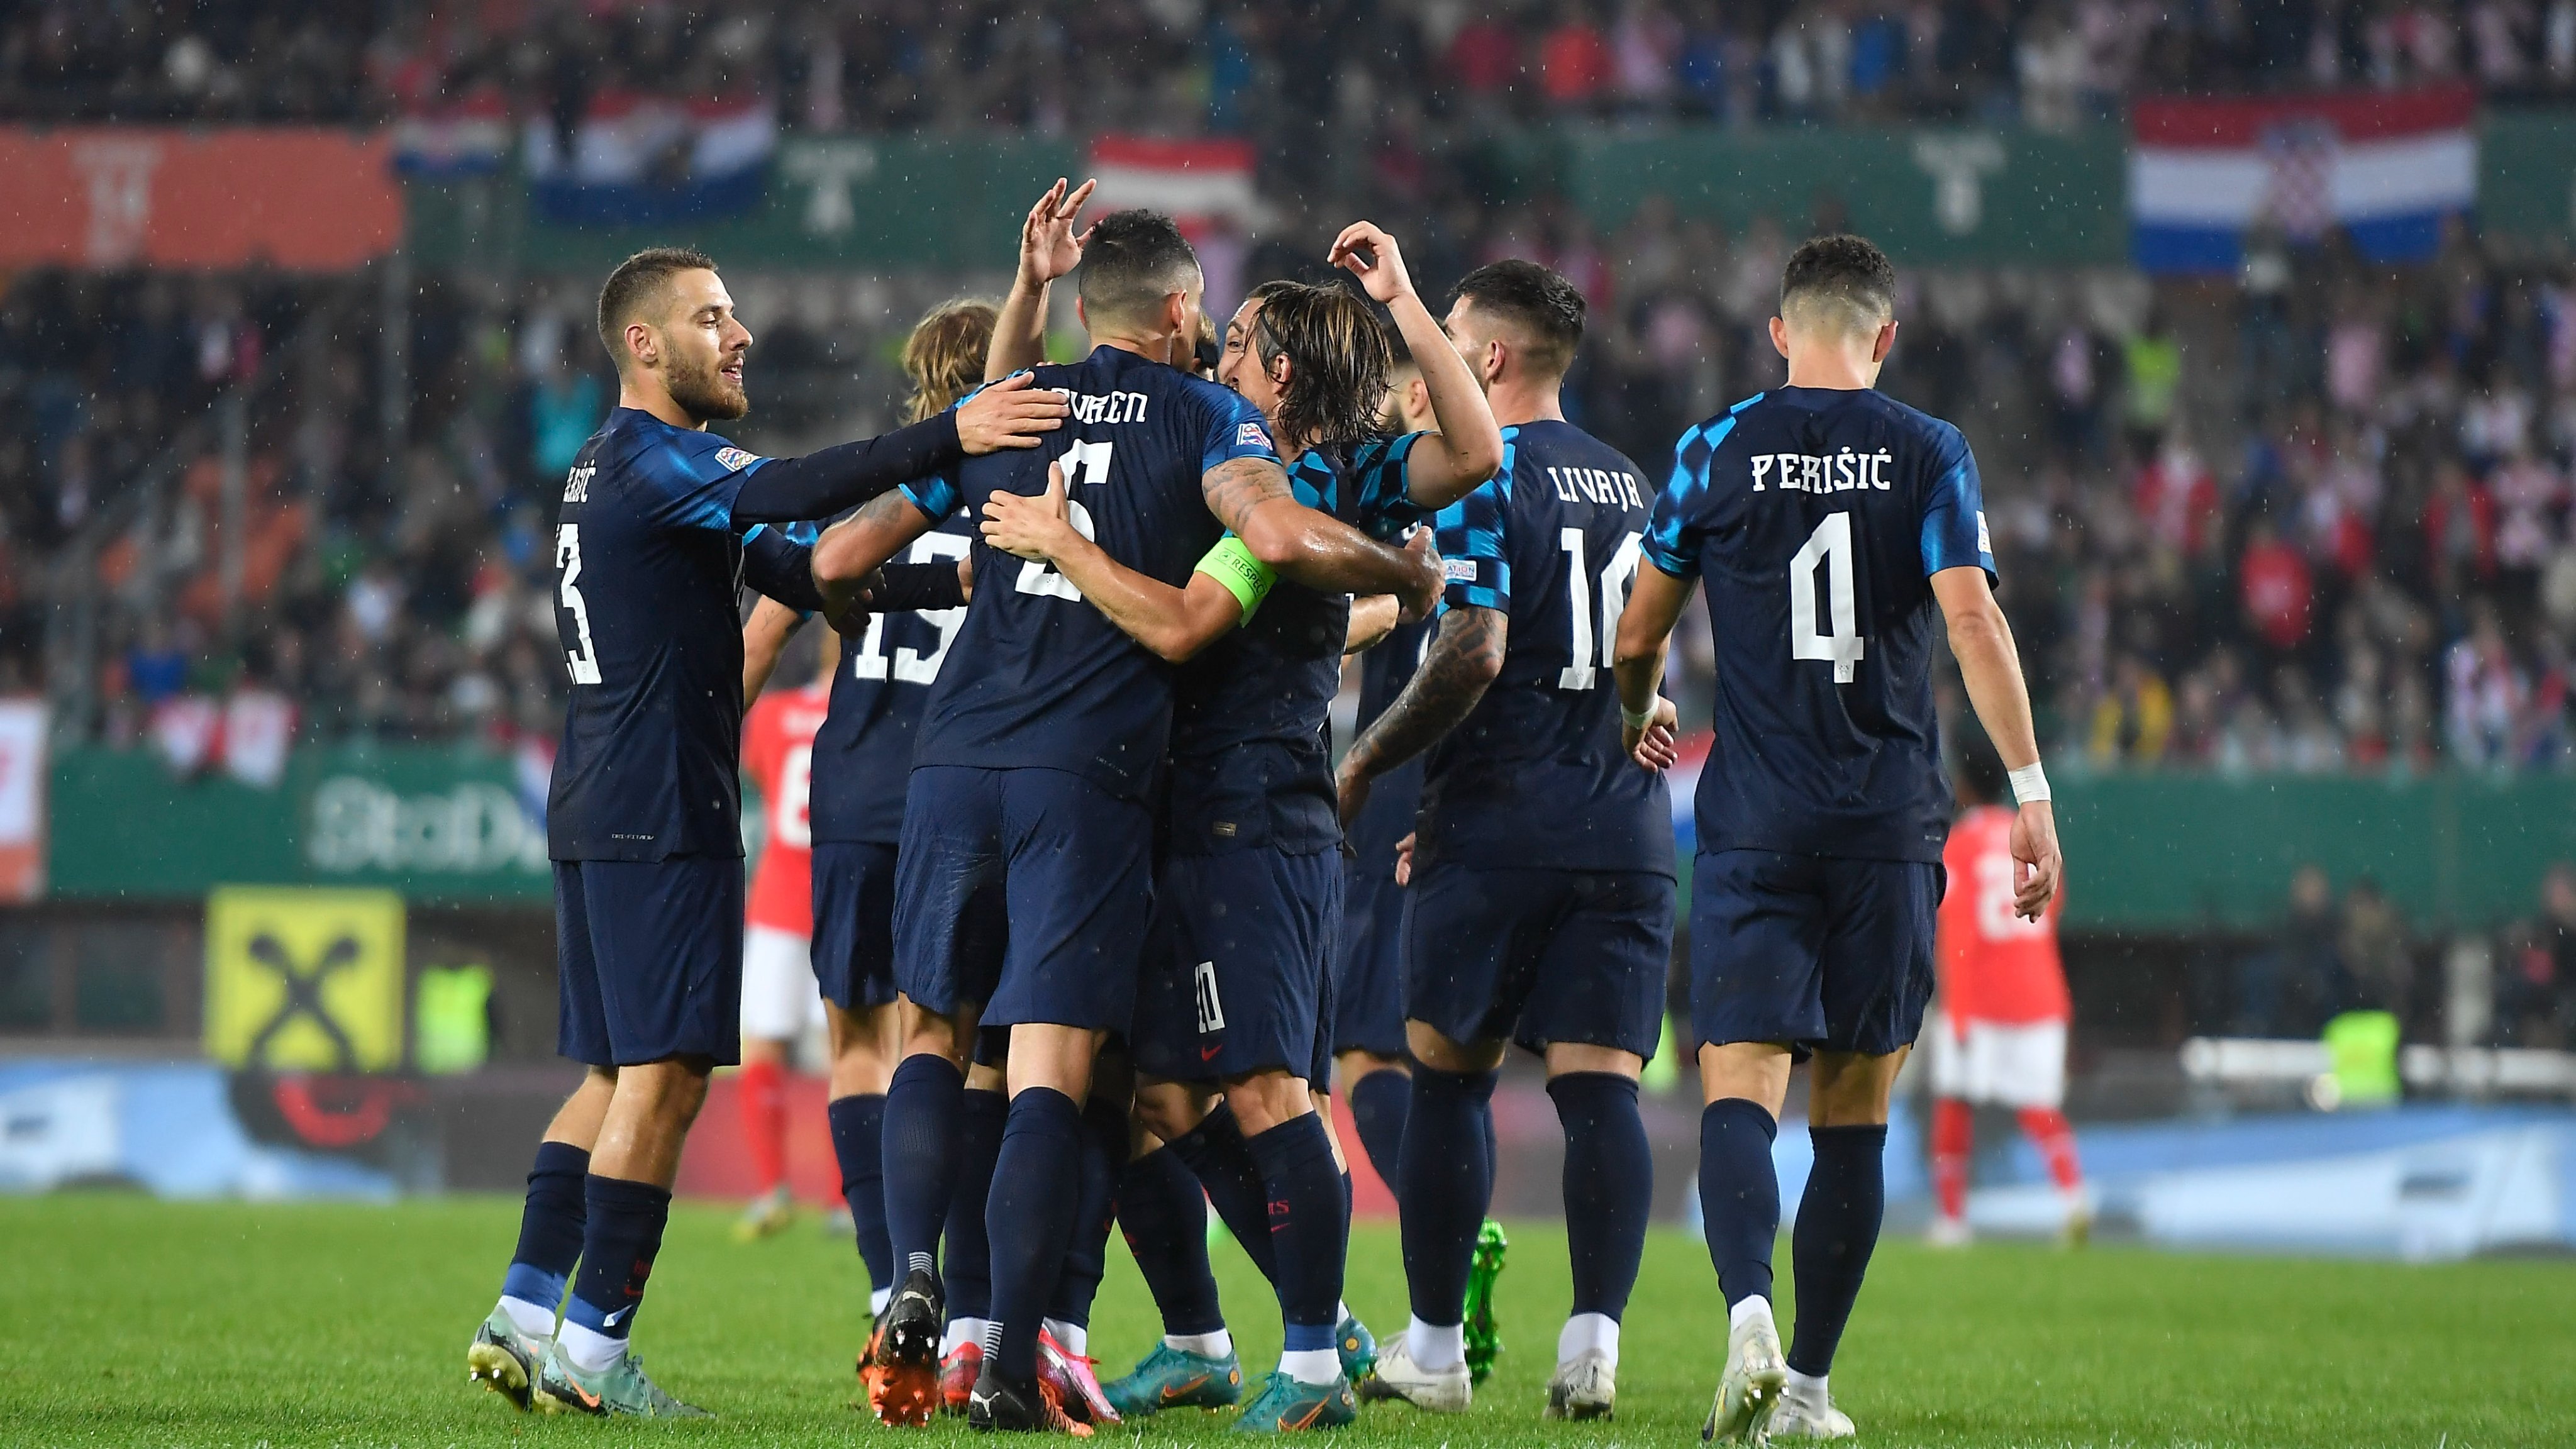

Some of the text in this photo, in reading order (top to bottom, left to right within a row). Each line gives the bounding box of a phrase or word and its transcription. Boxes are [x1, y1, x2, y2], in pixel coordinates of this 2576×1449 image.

[1547, 467, 1644, 513] LIVAJA
[1751, 447, 1892, 494] PERIŠIĆ
[1790, 511, 1863, 683] 4
[1195, 961, 1225, 1033] 10
